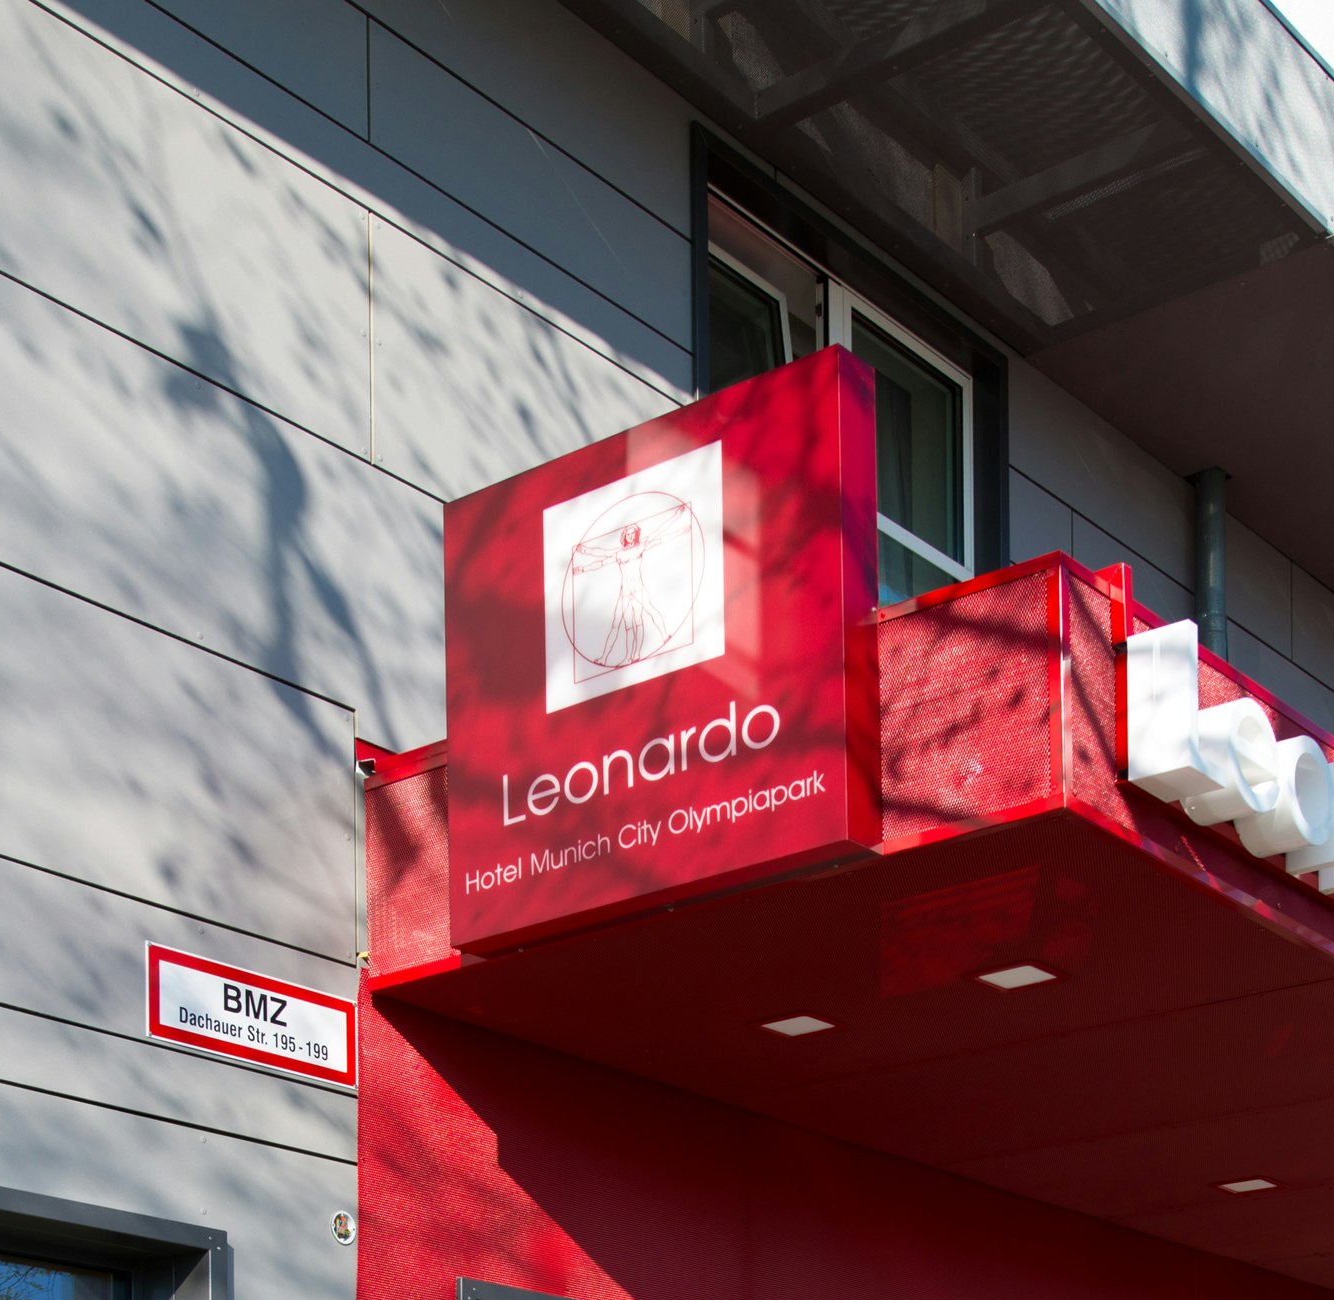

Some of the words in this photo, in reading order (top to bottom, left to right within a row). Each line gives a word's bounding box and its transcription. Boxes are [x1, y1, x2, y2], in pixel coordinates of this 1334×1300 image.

[502, 700, 781, 827] Leonardo
[464, 857, 523, 895] Hotel
[530, 832, 612, 877] Munich
[617, 817, 662, 850] City
[667, 769, 827, 836] Olympiapark
[178, 1006, 243, 1038] Dachauer
[247, 1025, 269, 1045] Str.
[223, 982, 288, 1027] BMZ
